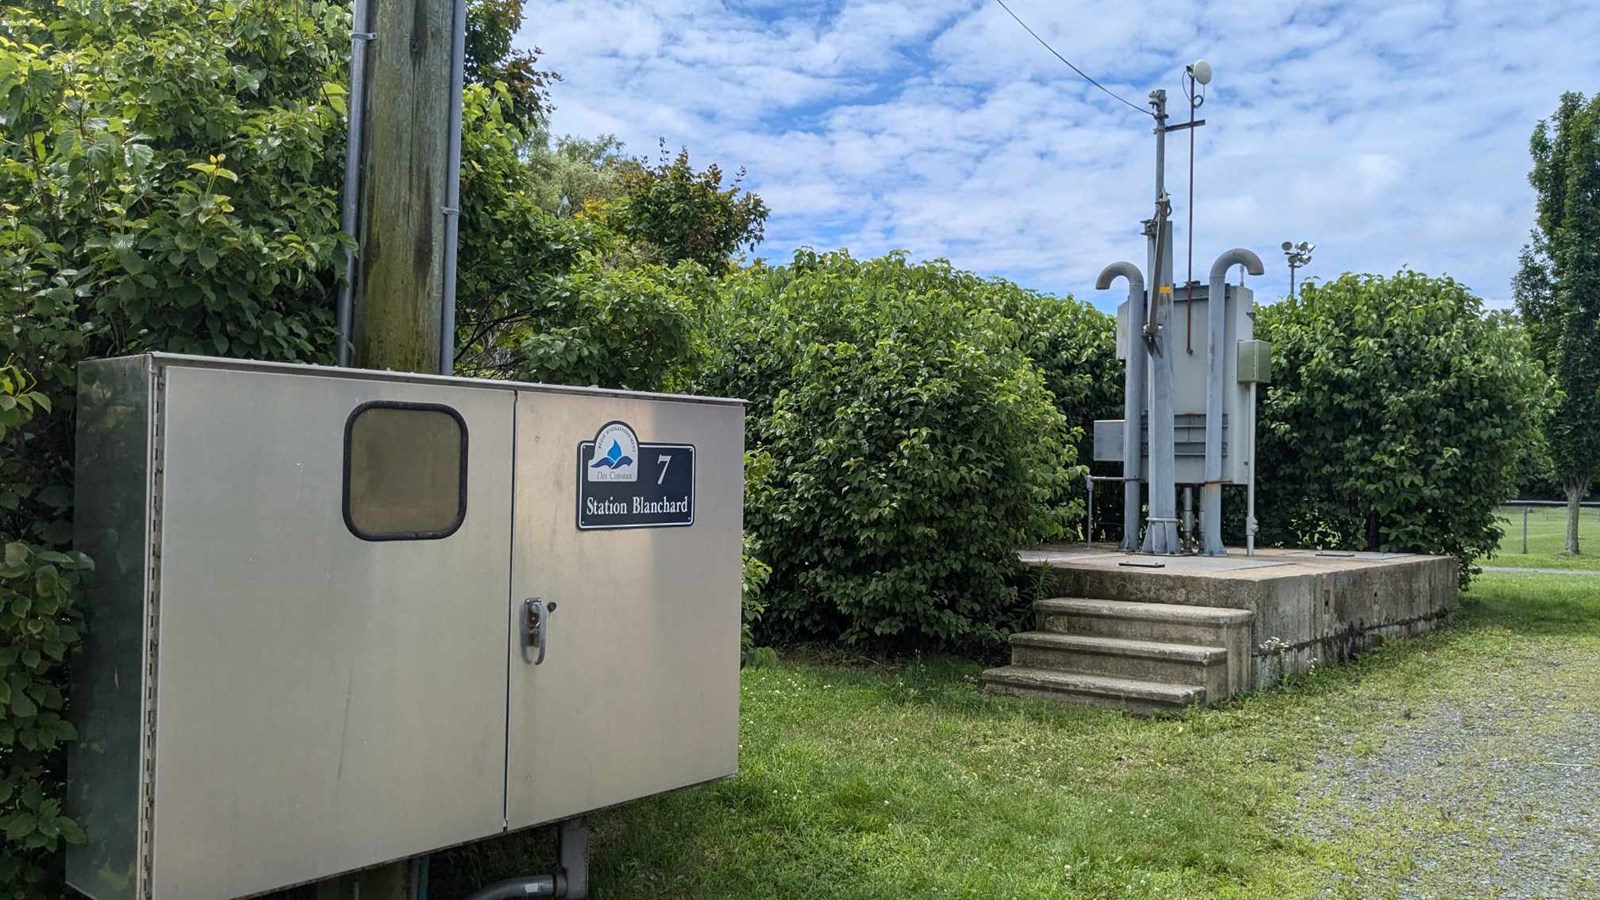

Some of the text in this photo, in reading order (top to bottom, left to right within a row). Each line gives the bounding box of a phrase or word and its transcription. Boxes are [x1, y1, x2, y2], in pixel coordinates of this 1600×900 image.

[657, 453, 672, 485] 7
[586, 496, 688, 515] Station Blanchard
